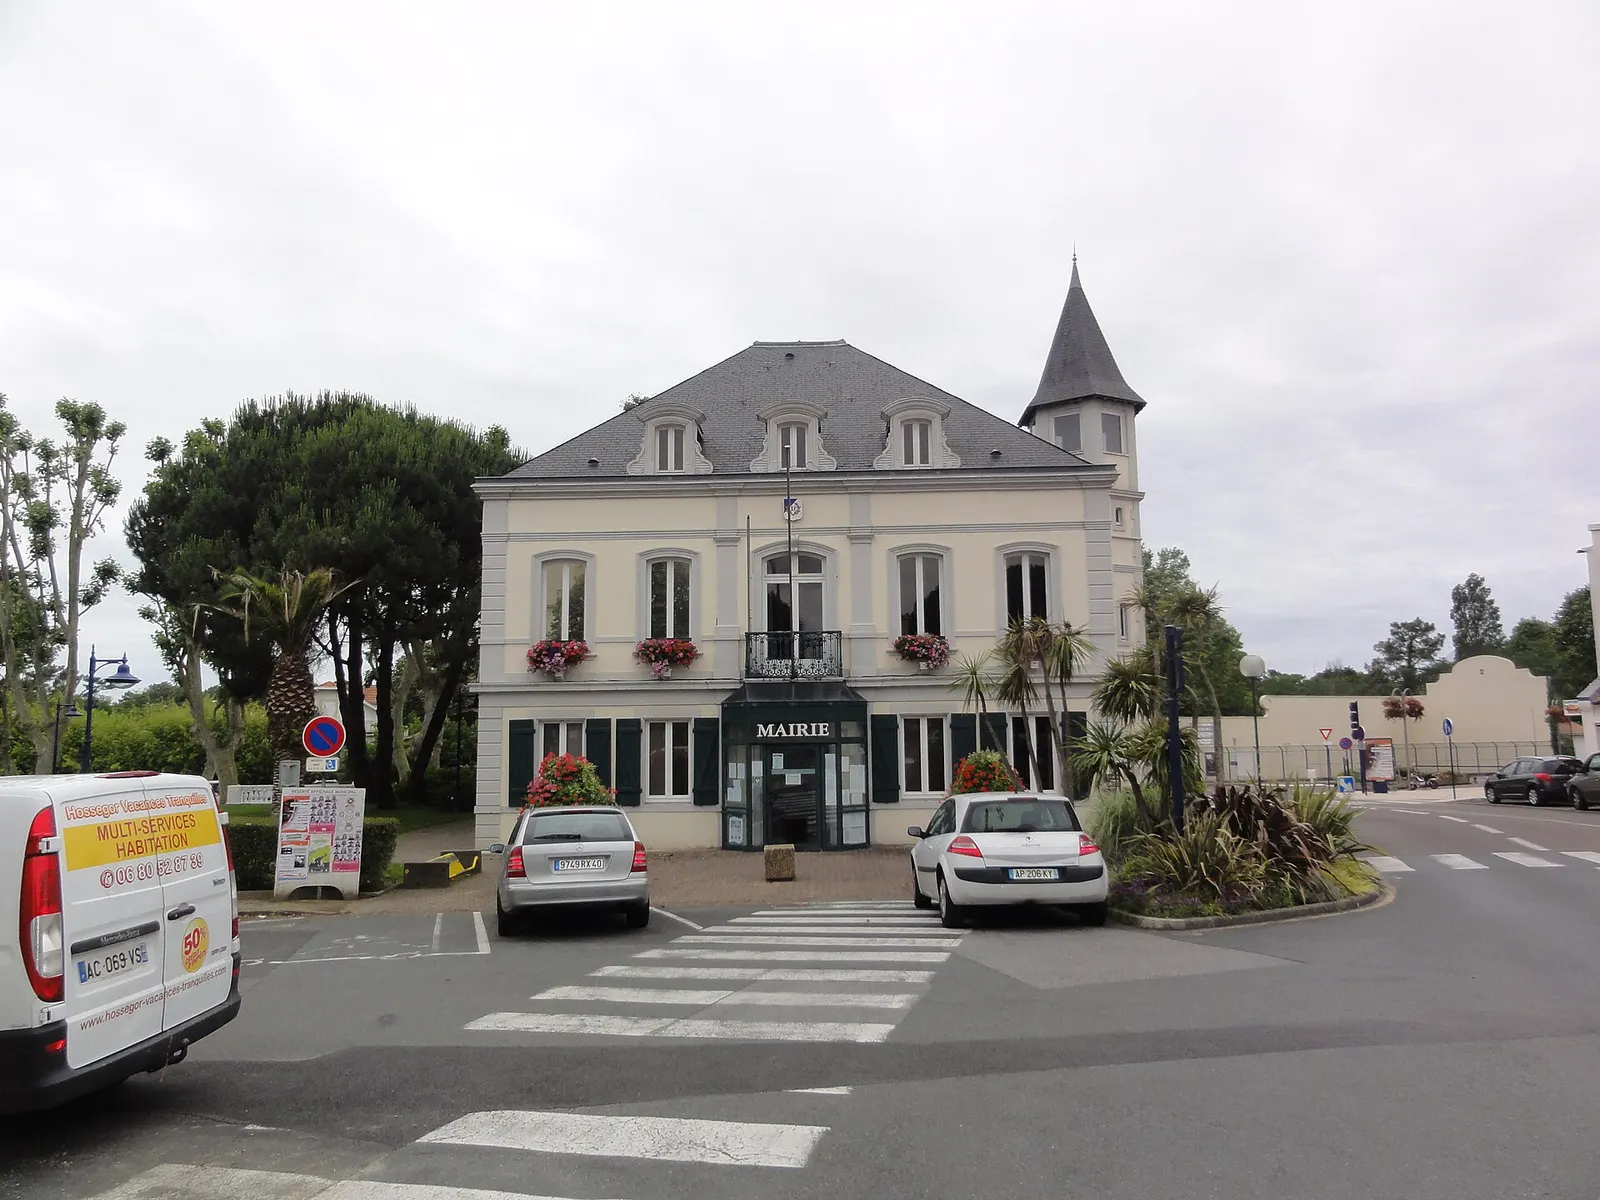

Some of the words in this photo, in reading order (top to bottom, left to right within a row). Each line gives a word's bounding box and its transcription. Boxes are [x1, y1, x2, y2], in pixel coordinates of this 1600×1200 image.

[756, 723, 830, 738] MAIRIE
[65, 803, 120, 820] Hossegor
[120, 797, 166, 813] Vacances
[165, 792, 207, 807] Tranquilles
[97, 814, 196, 841] MULTI-SERVICES
[116, 832, 188, 858] HABITATION
[116, 866, 134, 885] 06
[137, 862, 154, 880] 80
[157, 858, 173, 876] 52
[174, 855, 188, 872] 87
[190, 852, 204, 868] 39
[560, 861, 580, 869] 9749
[184, 927, 206, 955] 50%
[80, 965, 227, 1030] www.hossegor-vacances-tranquilles.com
